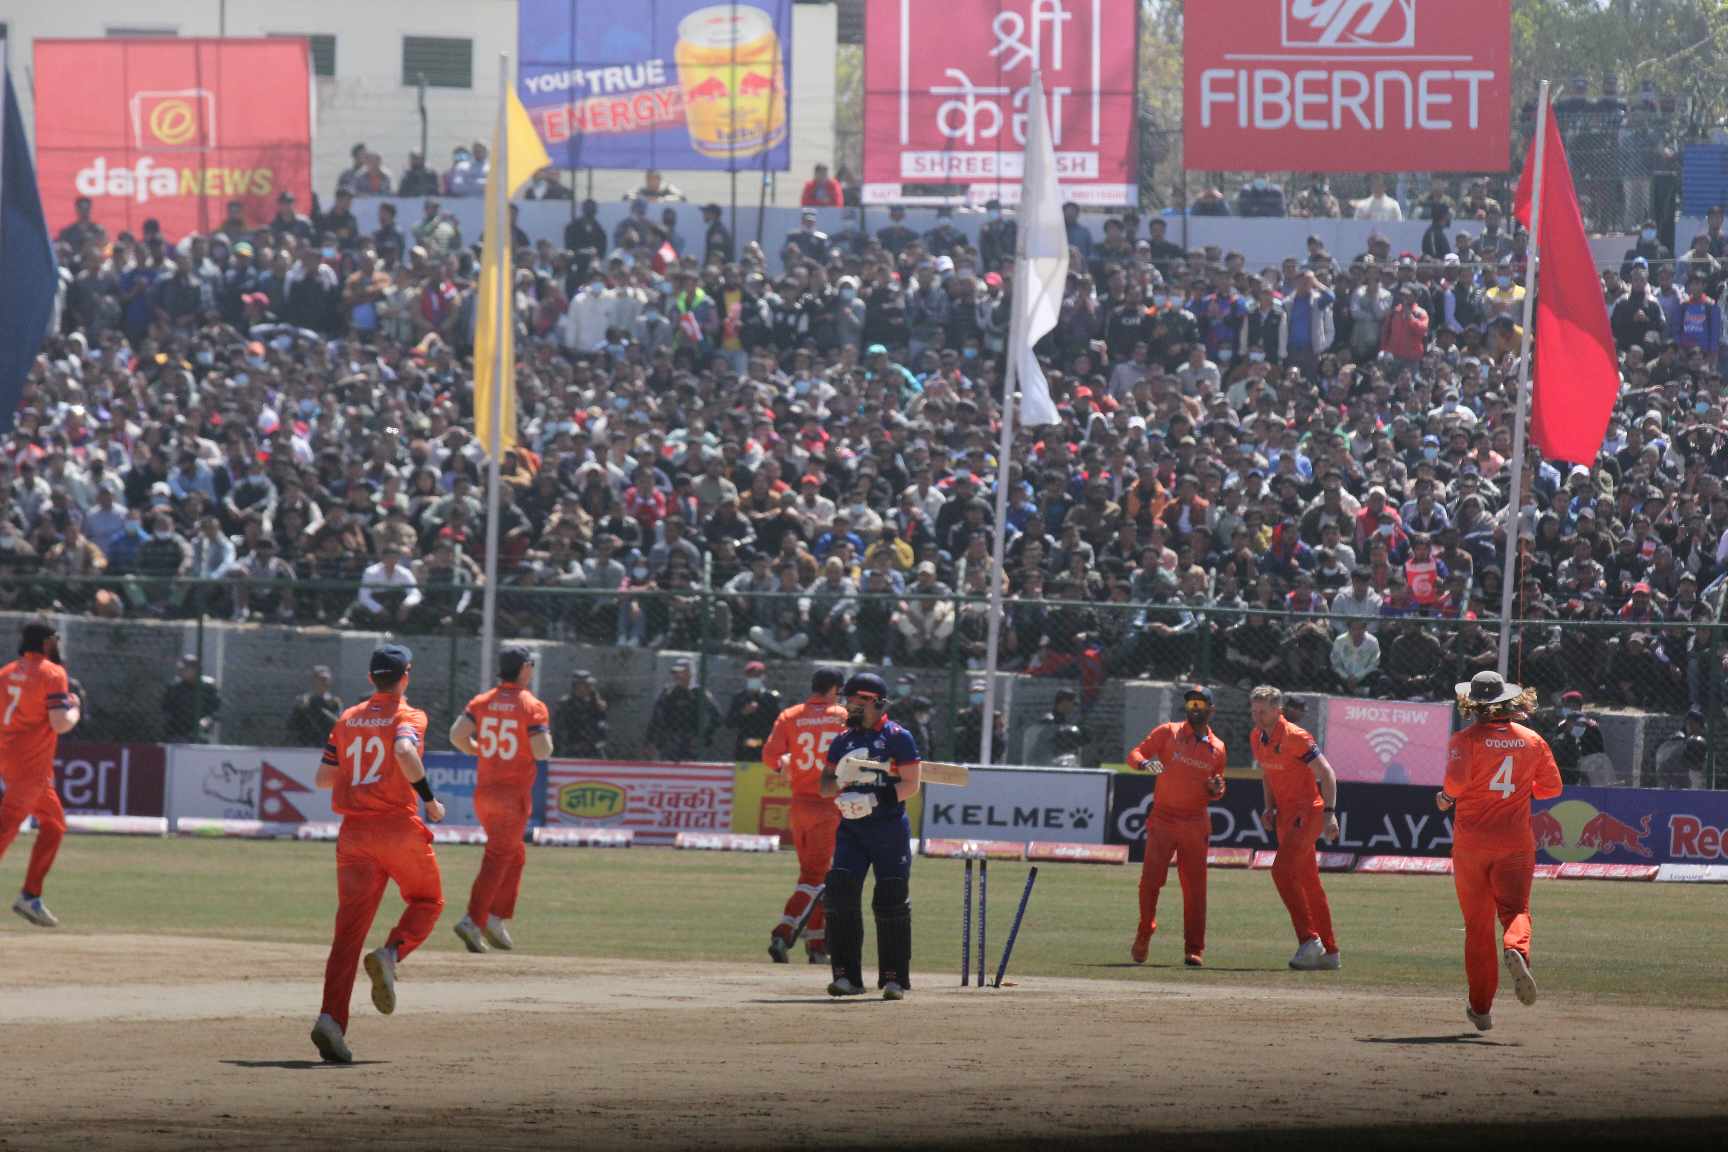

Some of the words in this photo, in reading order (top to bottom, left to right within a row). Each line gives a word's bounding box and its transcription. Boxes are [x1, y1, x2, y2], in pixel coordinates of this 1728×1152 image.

[525, 70, 584, 94] YOUR
[584, 59, 666, 94] TRUE
[545, 88, 677, 143] ENERGY
[1201, 69, 1495, 129] FIBERNET
[913, 157, 993, 173] SHREE
[480, 716, 519, 760] 55
[796, 731, 839, 771] 35
[346, 735, 385, 786] 12
[1488, 755, 1516, 799] 4
[932, 804, 1065, 829] KELME
